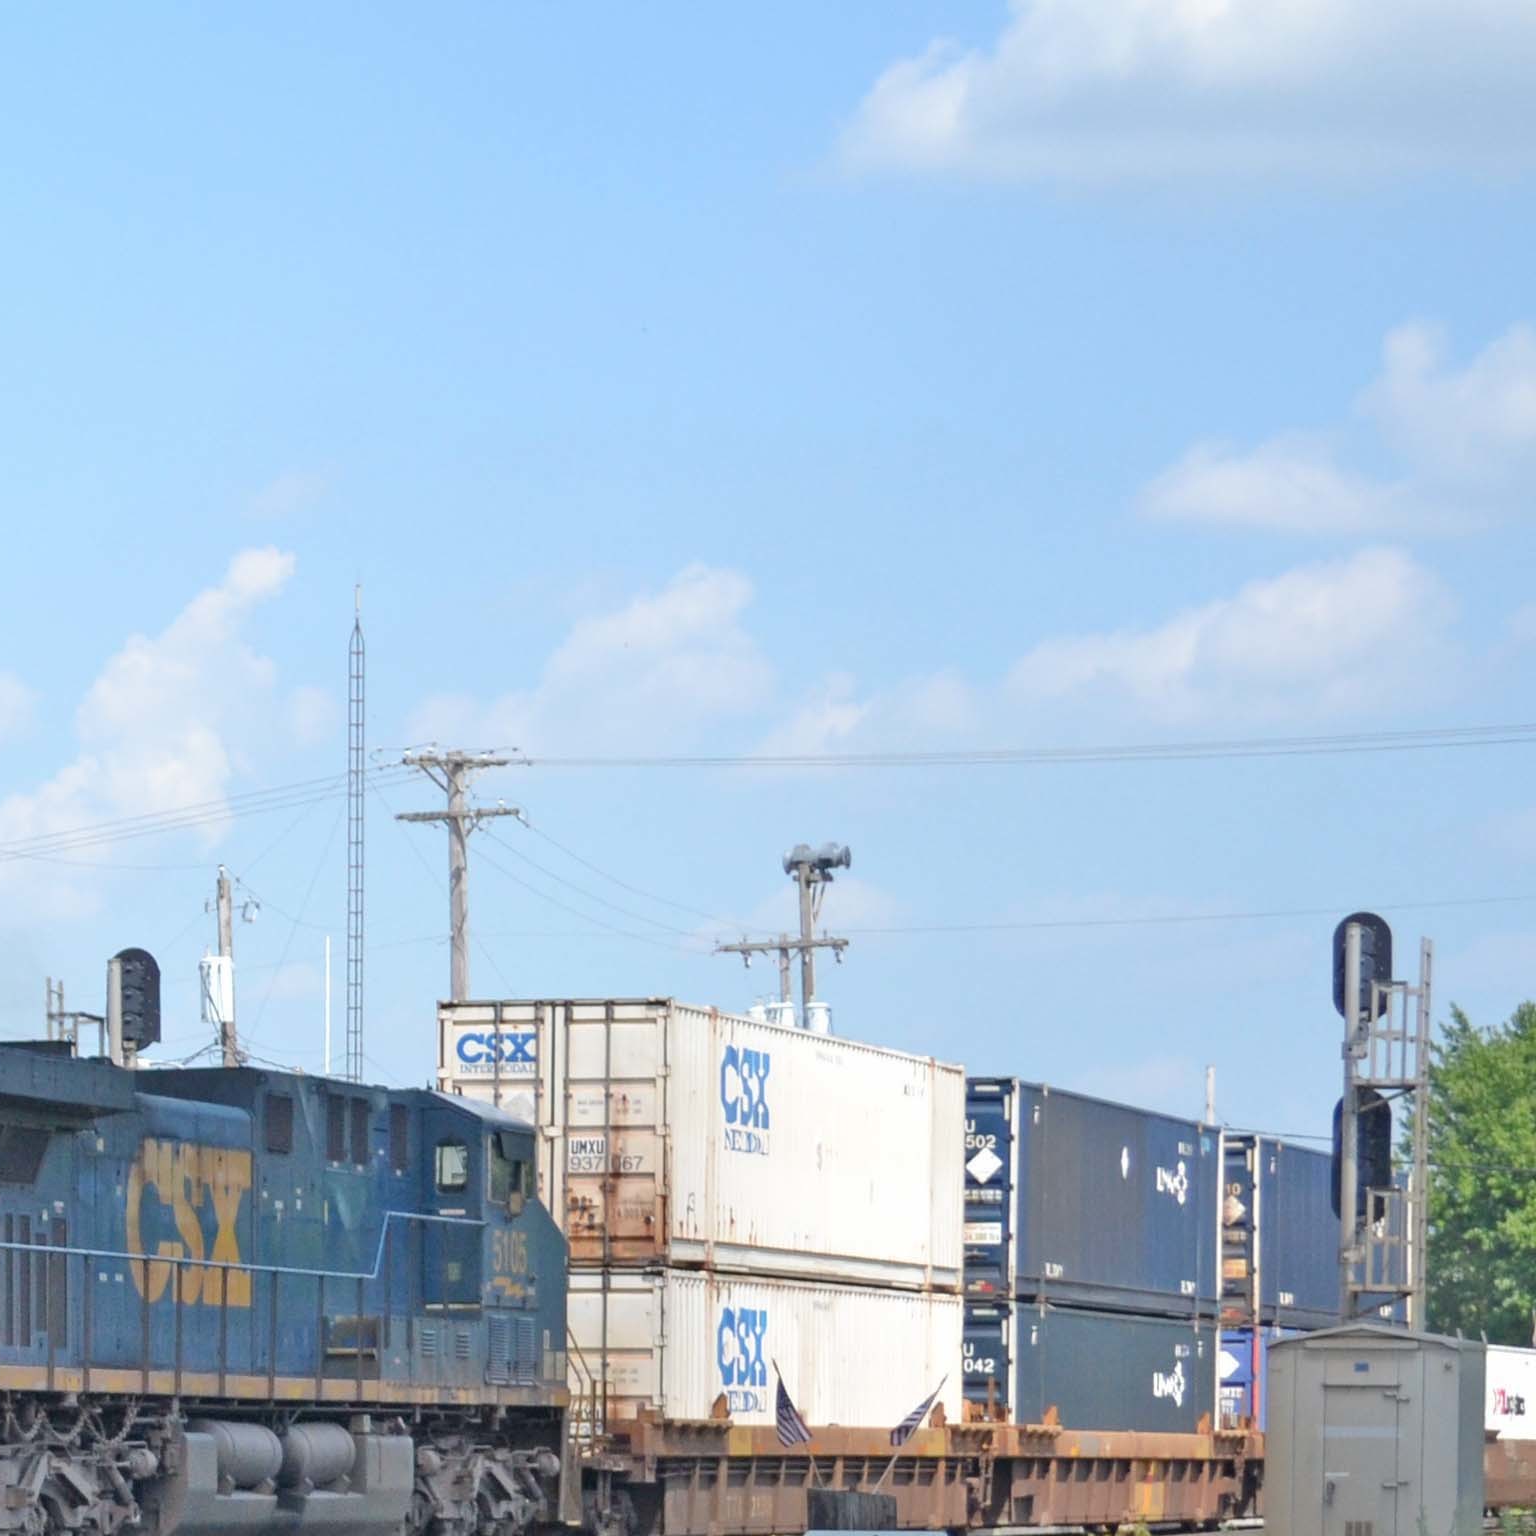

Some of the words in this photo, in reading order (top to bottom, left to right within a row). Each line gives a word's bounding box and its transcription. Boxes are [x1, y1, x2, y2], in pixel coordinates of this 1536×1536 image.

[456, 1033, 537, 1063] CSX
[721, 1044, 770, 1130] CSX
[571, 1140, 604, 1155] UMXU
[126, 1137, 252, 1307] CSX
[494, 1229, 527, 1273] 5105
[717, 1307, 767, 1386] CSX
